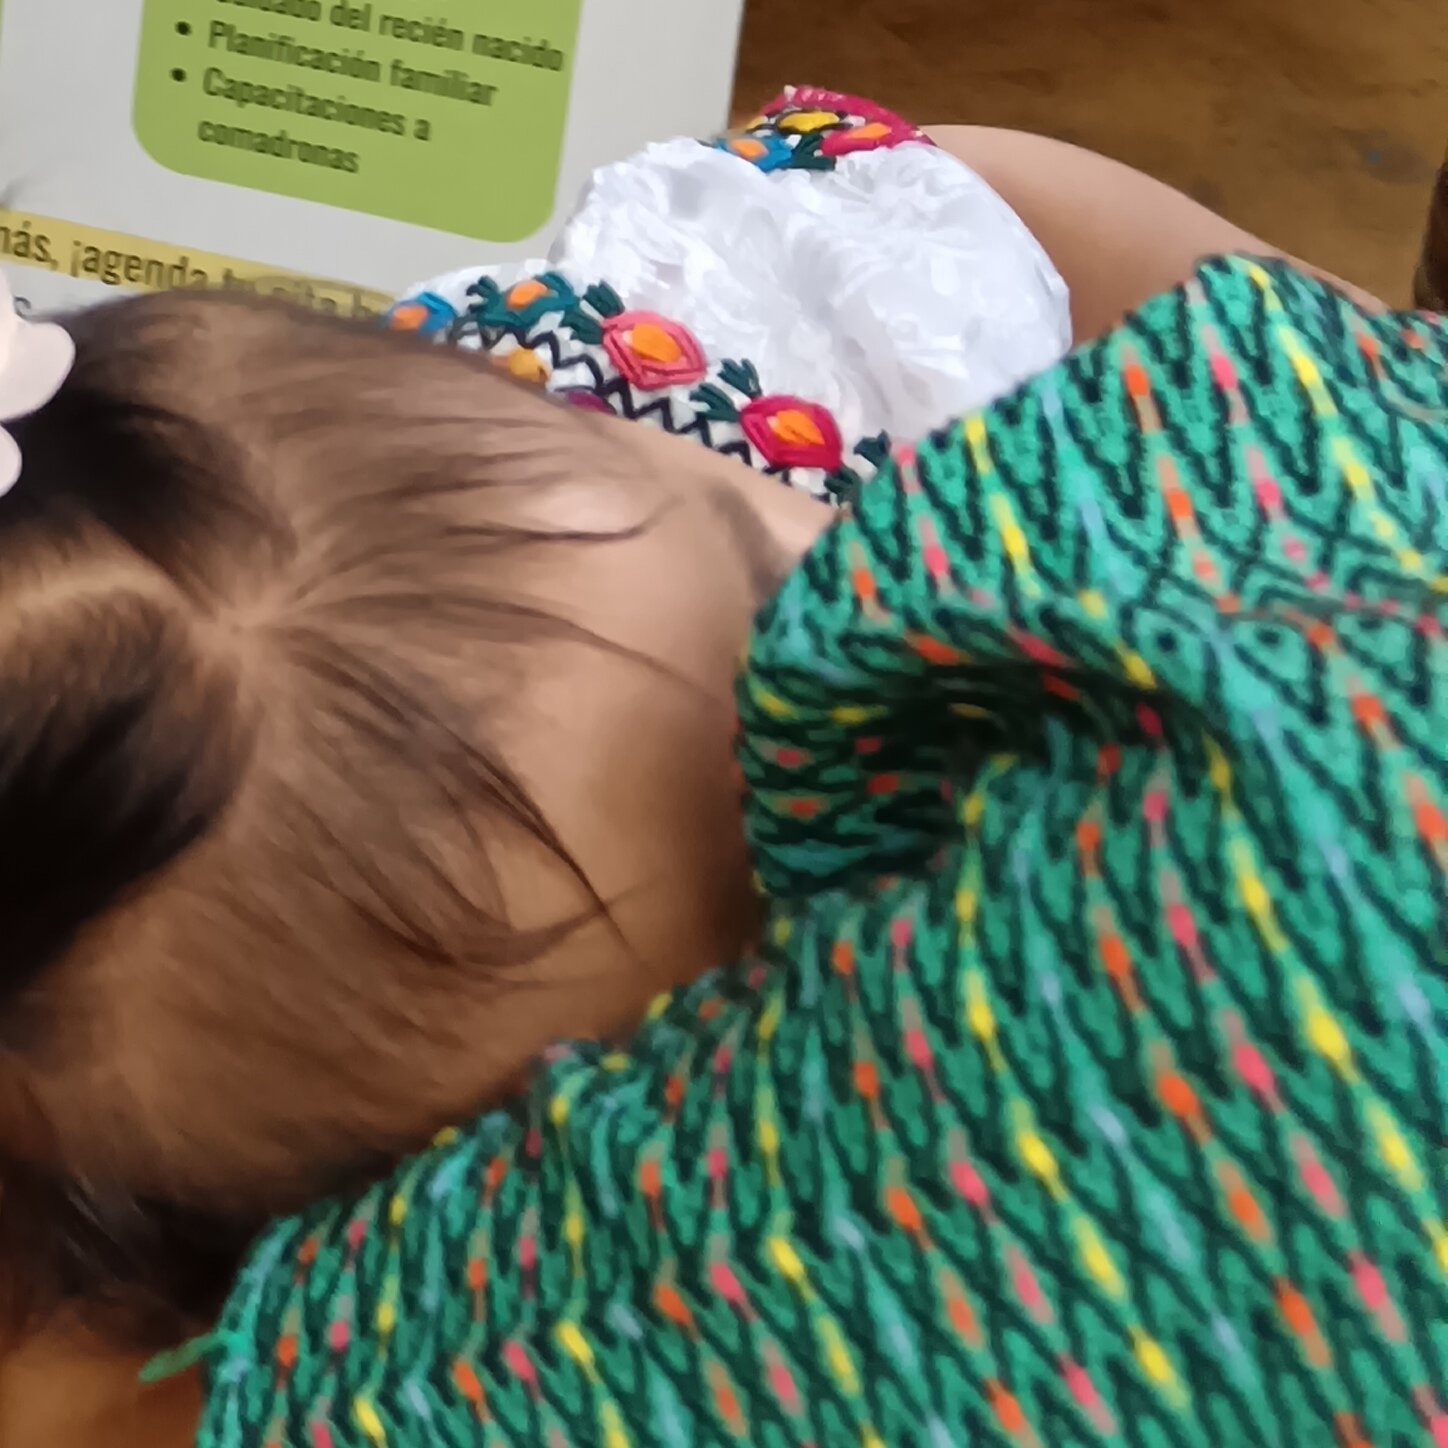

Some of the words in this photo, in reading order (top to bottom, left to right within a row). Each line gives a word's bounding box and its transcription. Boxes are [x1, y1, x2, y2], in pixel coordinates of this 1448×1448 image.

[207, 20, 381, 82] Planificación
[390, 60, 498, 105] familiar
[330, 0, 371, 31] del
[379, 13, 464, 51] recién
[471, 33, 565, 72] nacido
[203, 67, 405, 135] Capacitaciones
[197, 120, 359, 173] comadronas
